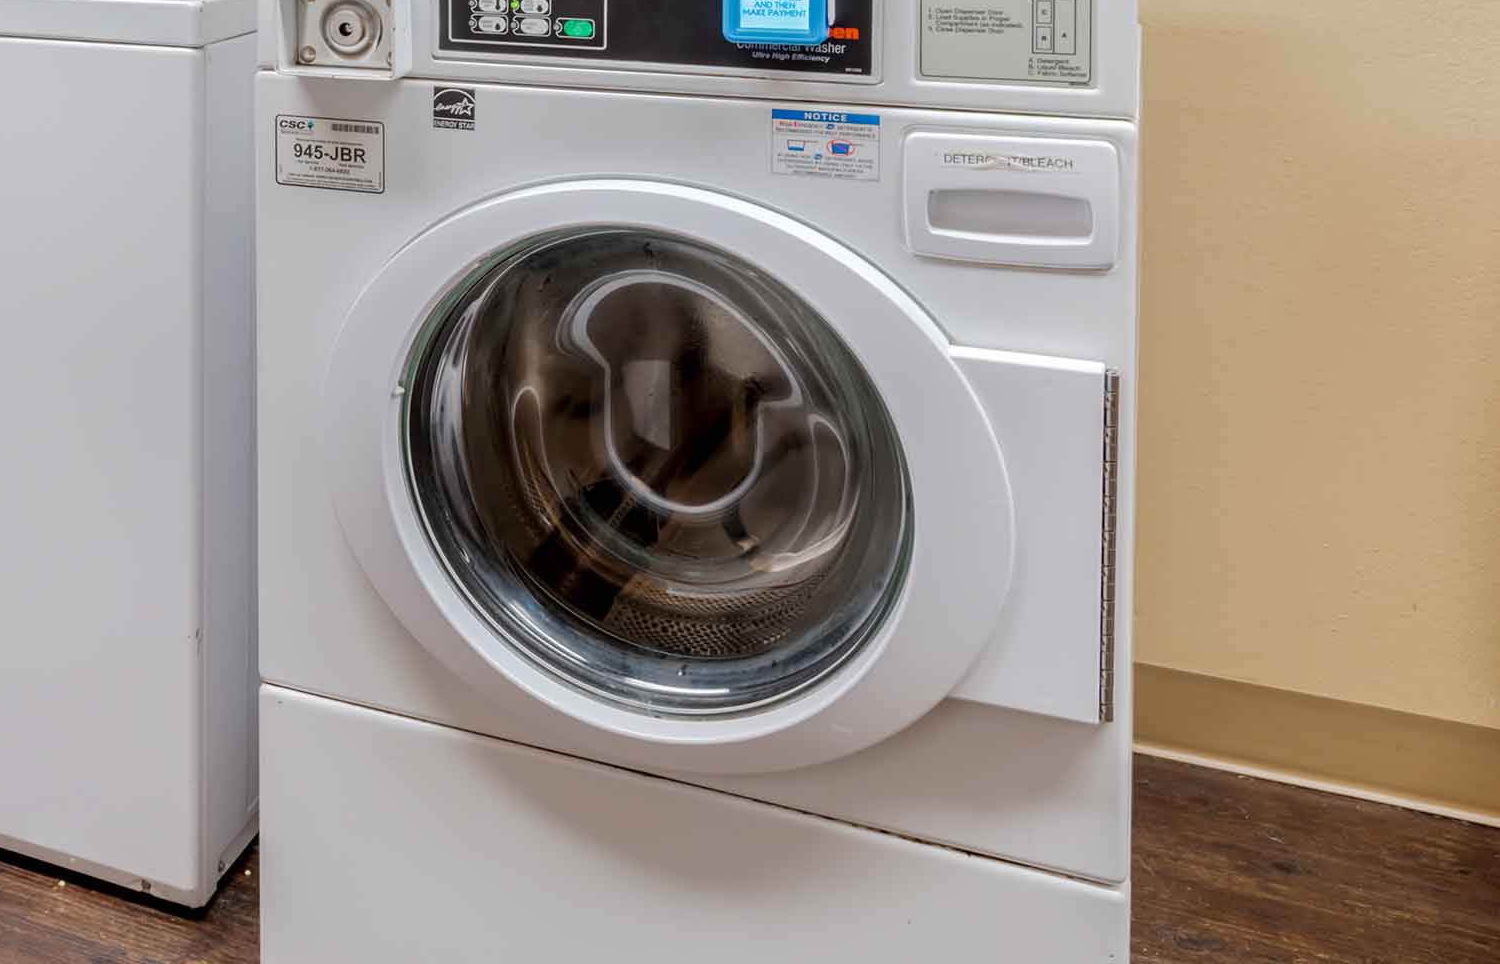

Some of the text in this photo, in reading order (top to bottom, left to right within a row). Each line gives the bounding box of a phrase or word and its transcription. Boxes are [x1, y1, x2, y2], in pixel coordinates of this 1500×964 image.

[754, 1, 772, 9] AND
[768, 9, 806, 17] PAYMENT
[804, 112, 848, 123] NOTICE
[279, 119, 306, 129] CSC
[293, 142, 367, 164] 945-JBR
